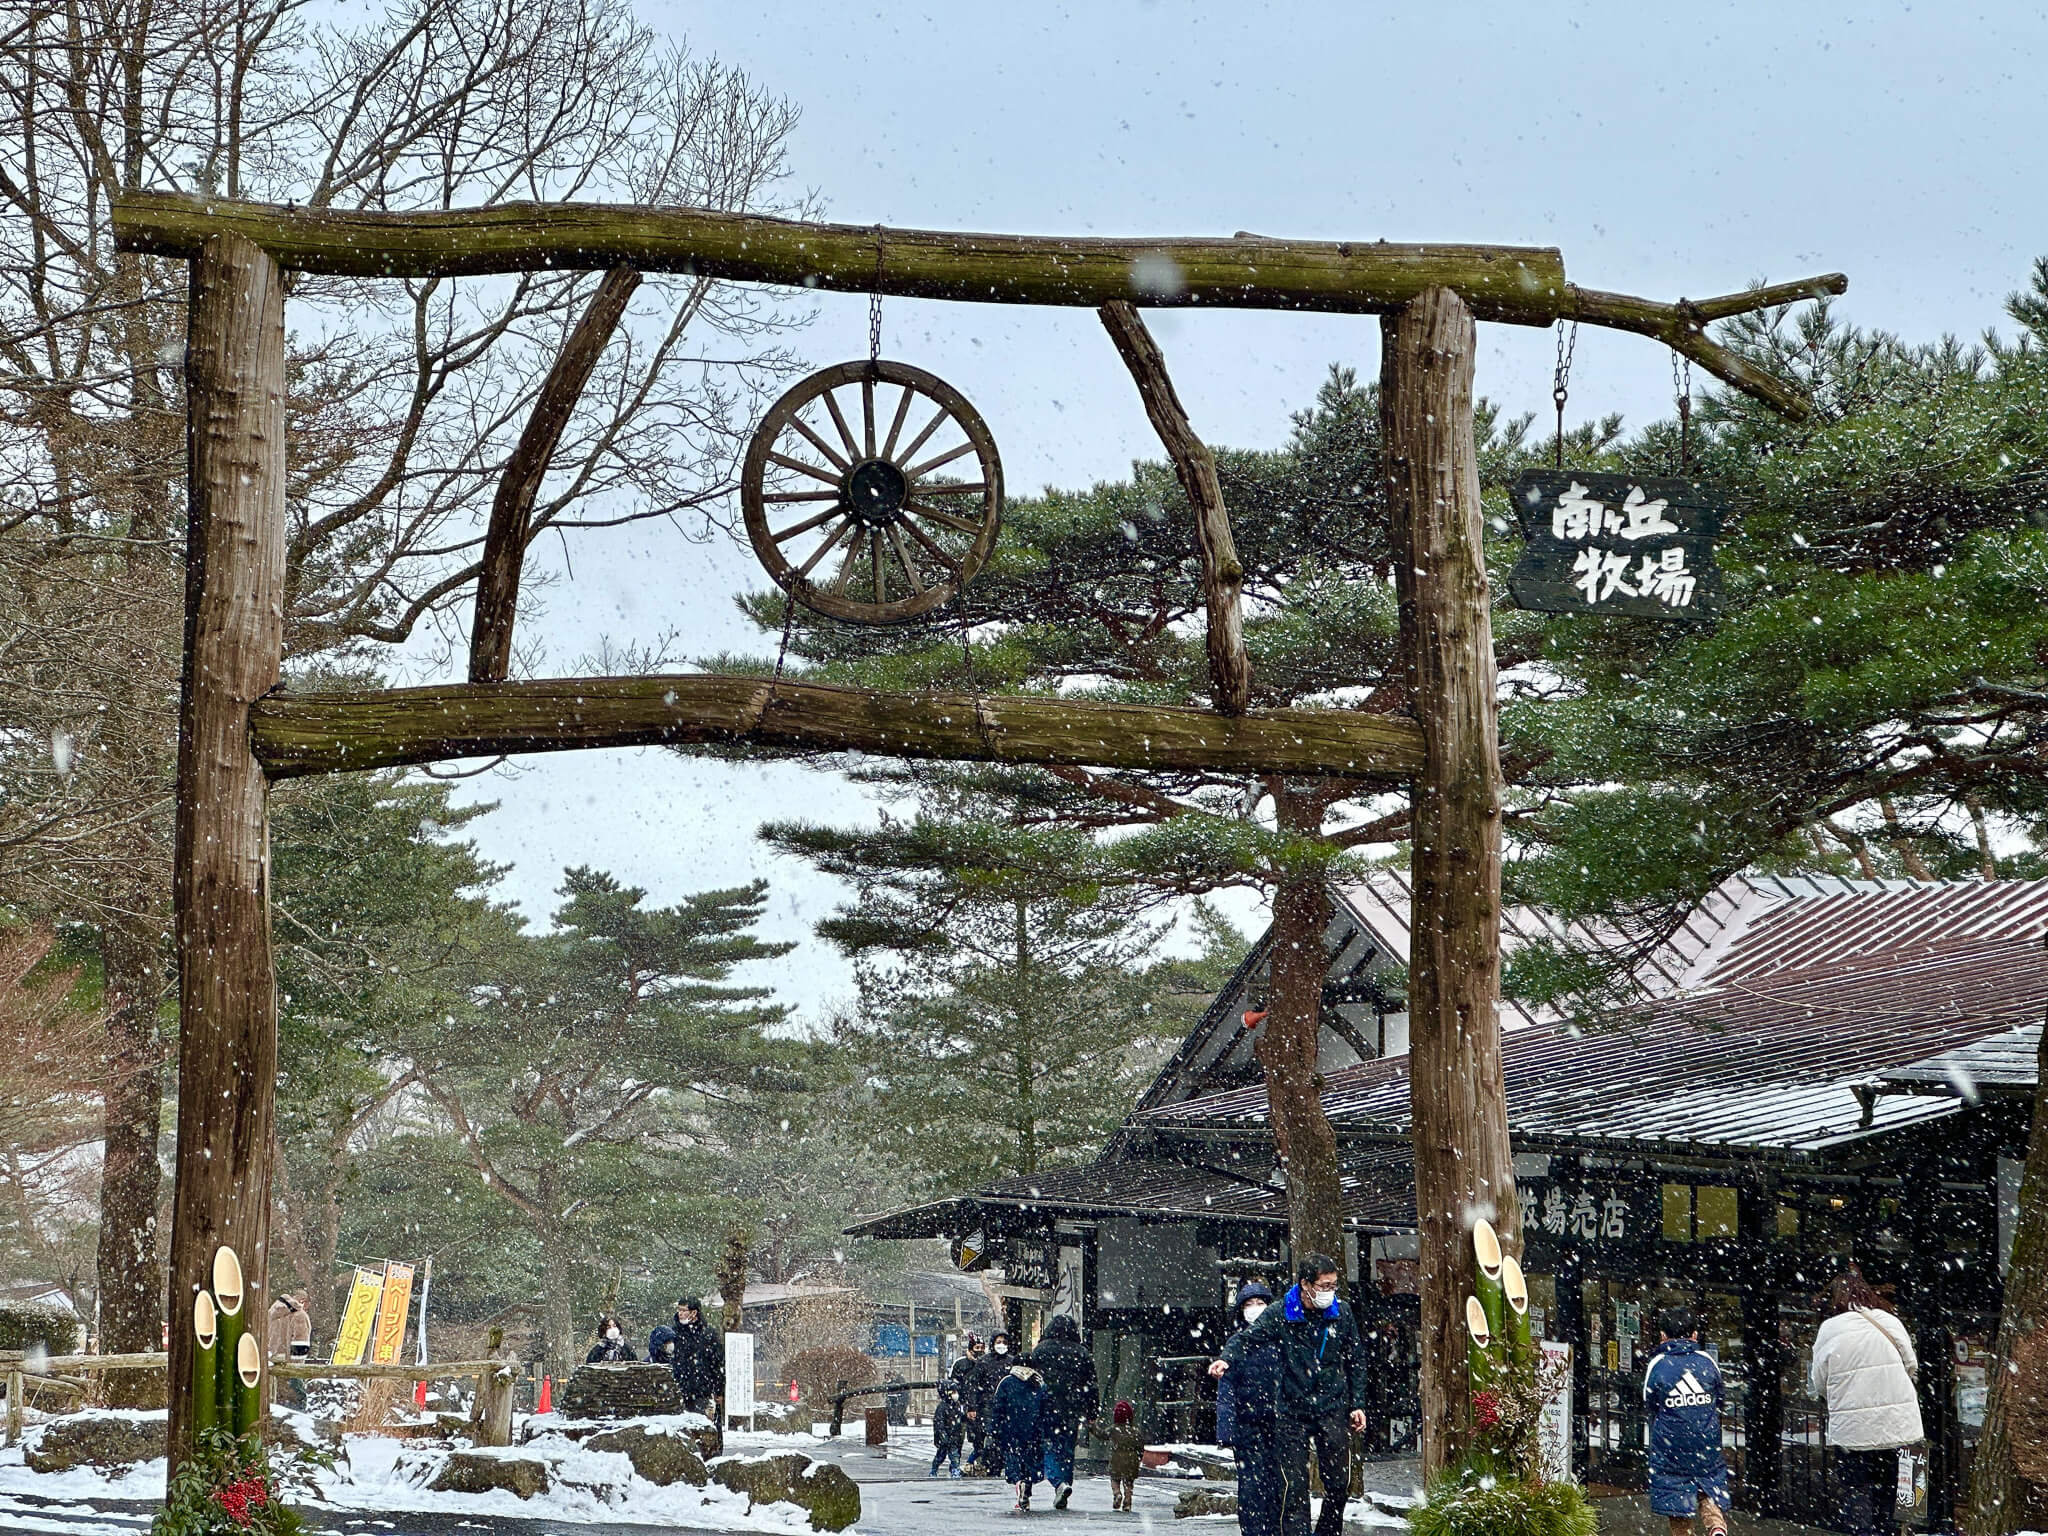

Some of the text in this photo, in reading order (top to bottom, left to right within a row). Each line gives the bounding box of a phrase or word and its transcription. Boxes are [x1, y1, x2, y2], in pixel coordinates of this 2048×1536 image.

[1573, 546, 1696, 607] 牧場
[341, 1290, 374, 1360] つくね串
[380, 1283, 406, 1362] ベーコン串
[1665, 1393, 1712, 1408] adidas
